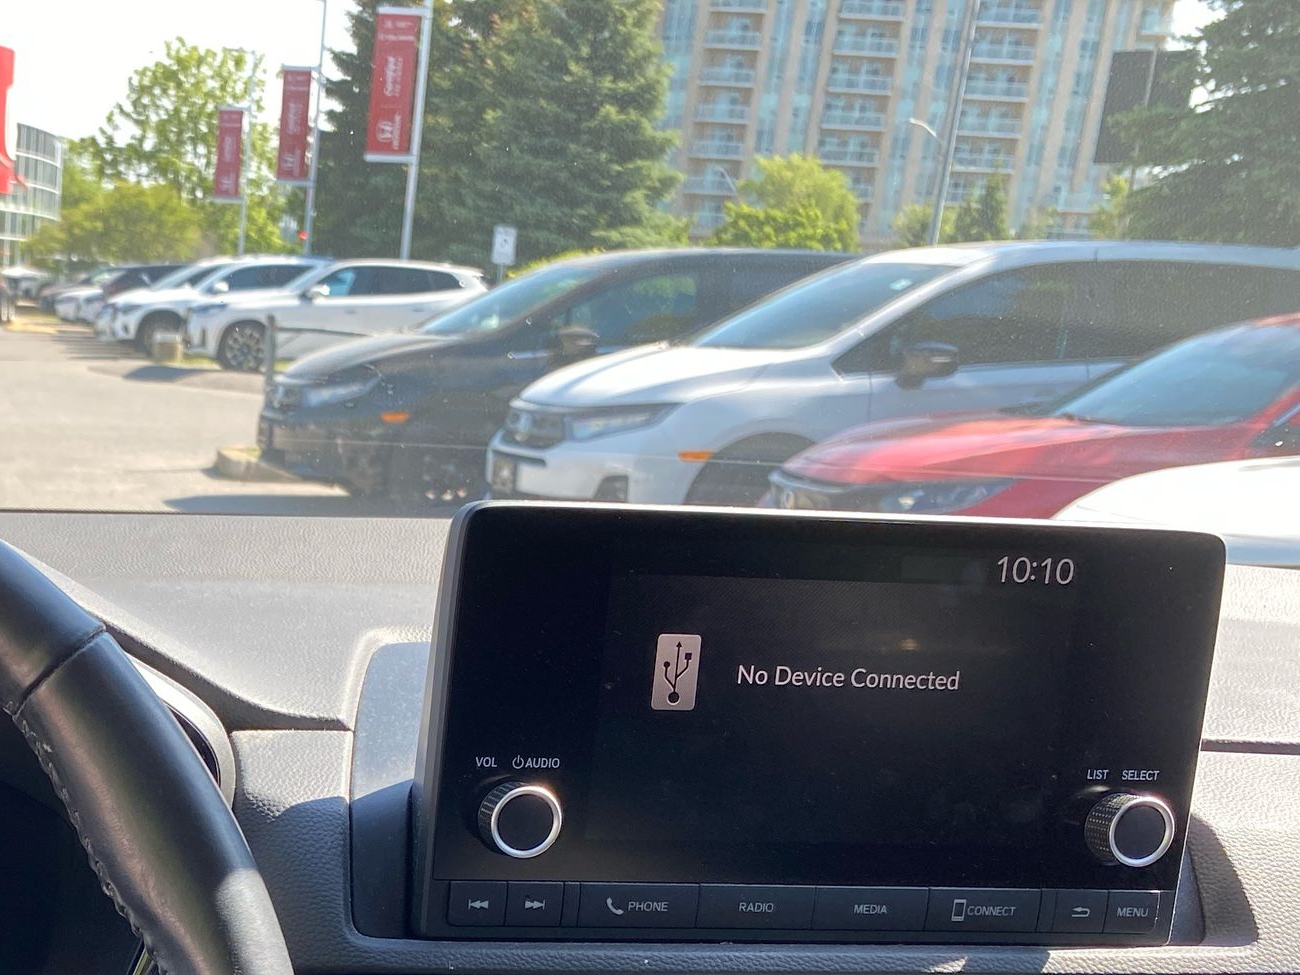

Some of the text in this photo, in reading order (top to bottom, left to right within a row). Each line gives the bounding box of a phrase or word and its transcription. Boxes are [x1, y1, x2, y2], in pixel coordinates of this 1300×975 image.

[997, 556, 1075, 585] 10:10
[737, 664, 960, 690] No Device Connected
[475, 756, 498, 768] VOL
[525, 757, 561, 769] AUDIO
[1086, 769, 1109, 780] LIST
[1121, 770, 1161, 781] SELECT
[628, 901, 669, 912] PHONE
[738, 903, 774, 913] RADIO
[853, 904, 887, 914] MEDIA
[967, 906, 1016, 917] CONNECT
[1116, 907, 1149, 917] MENU
